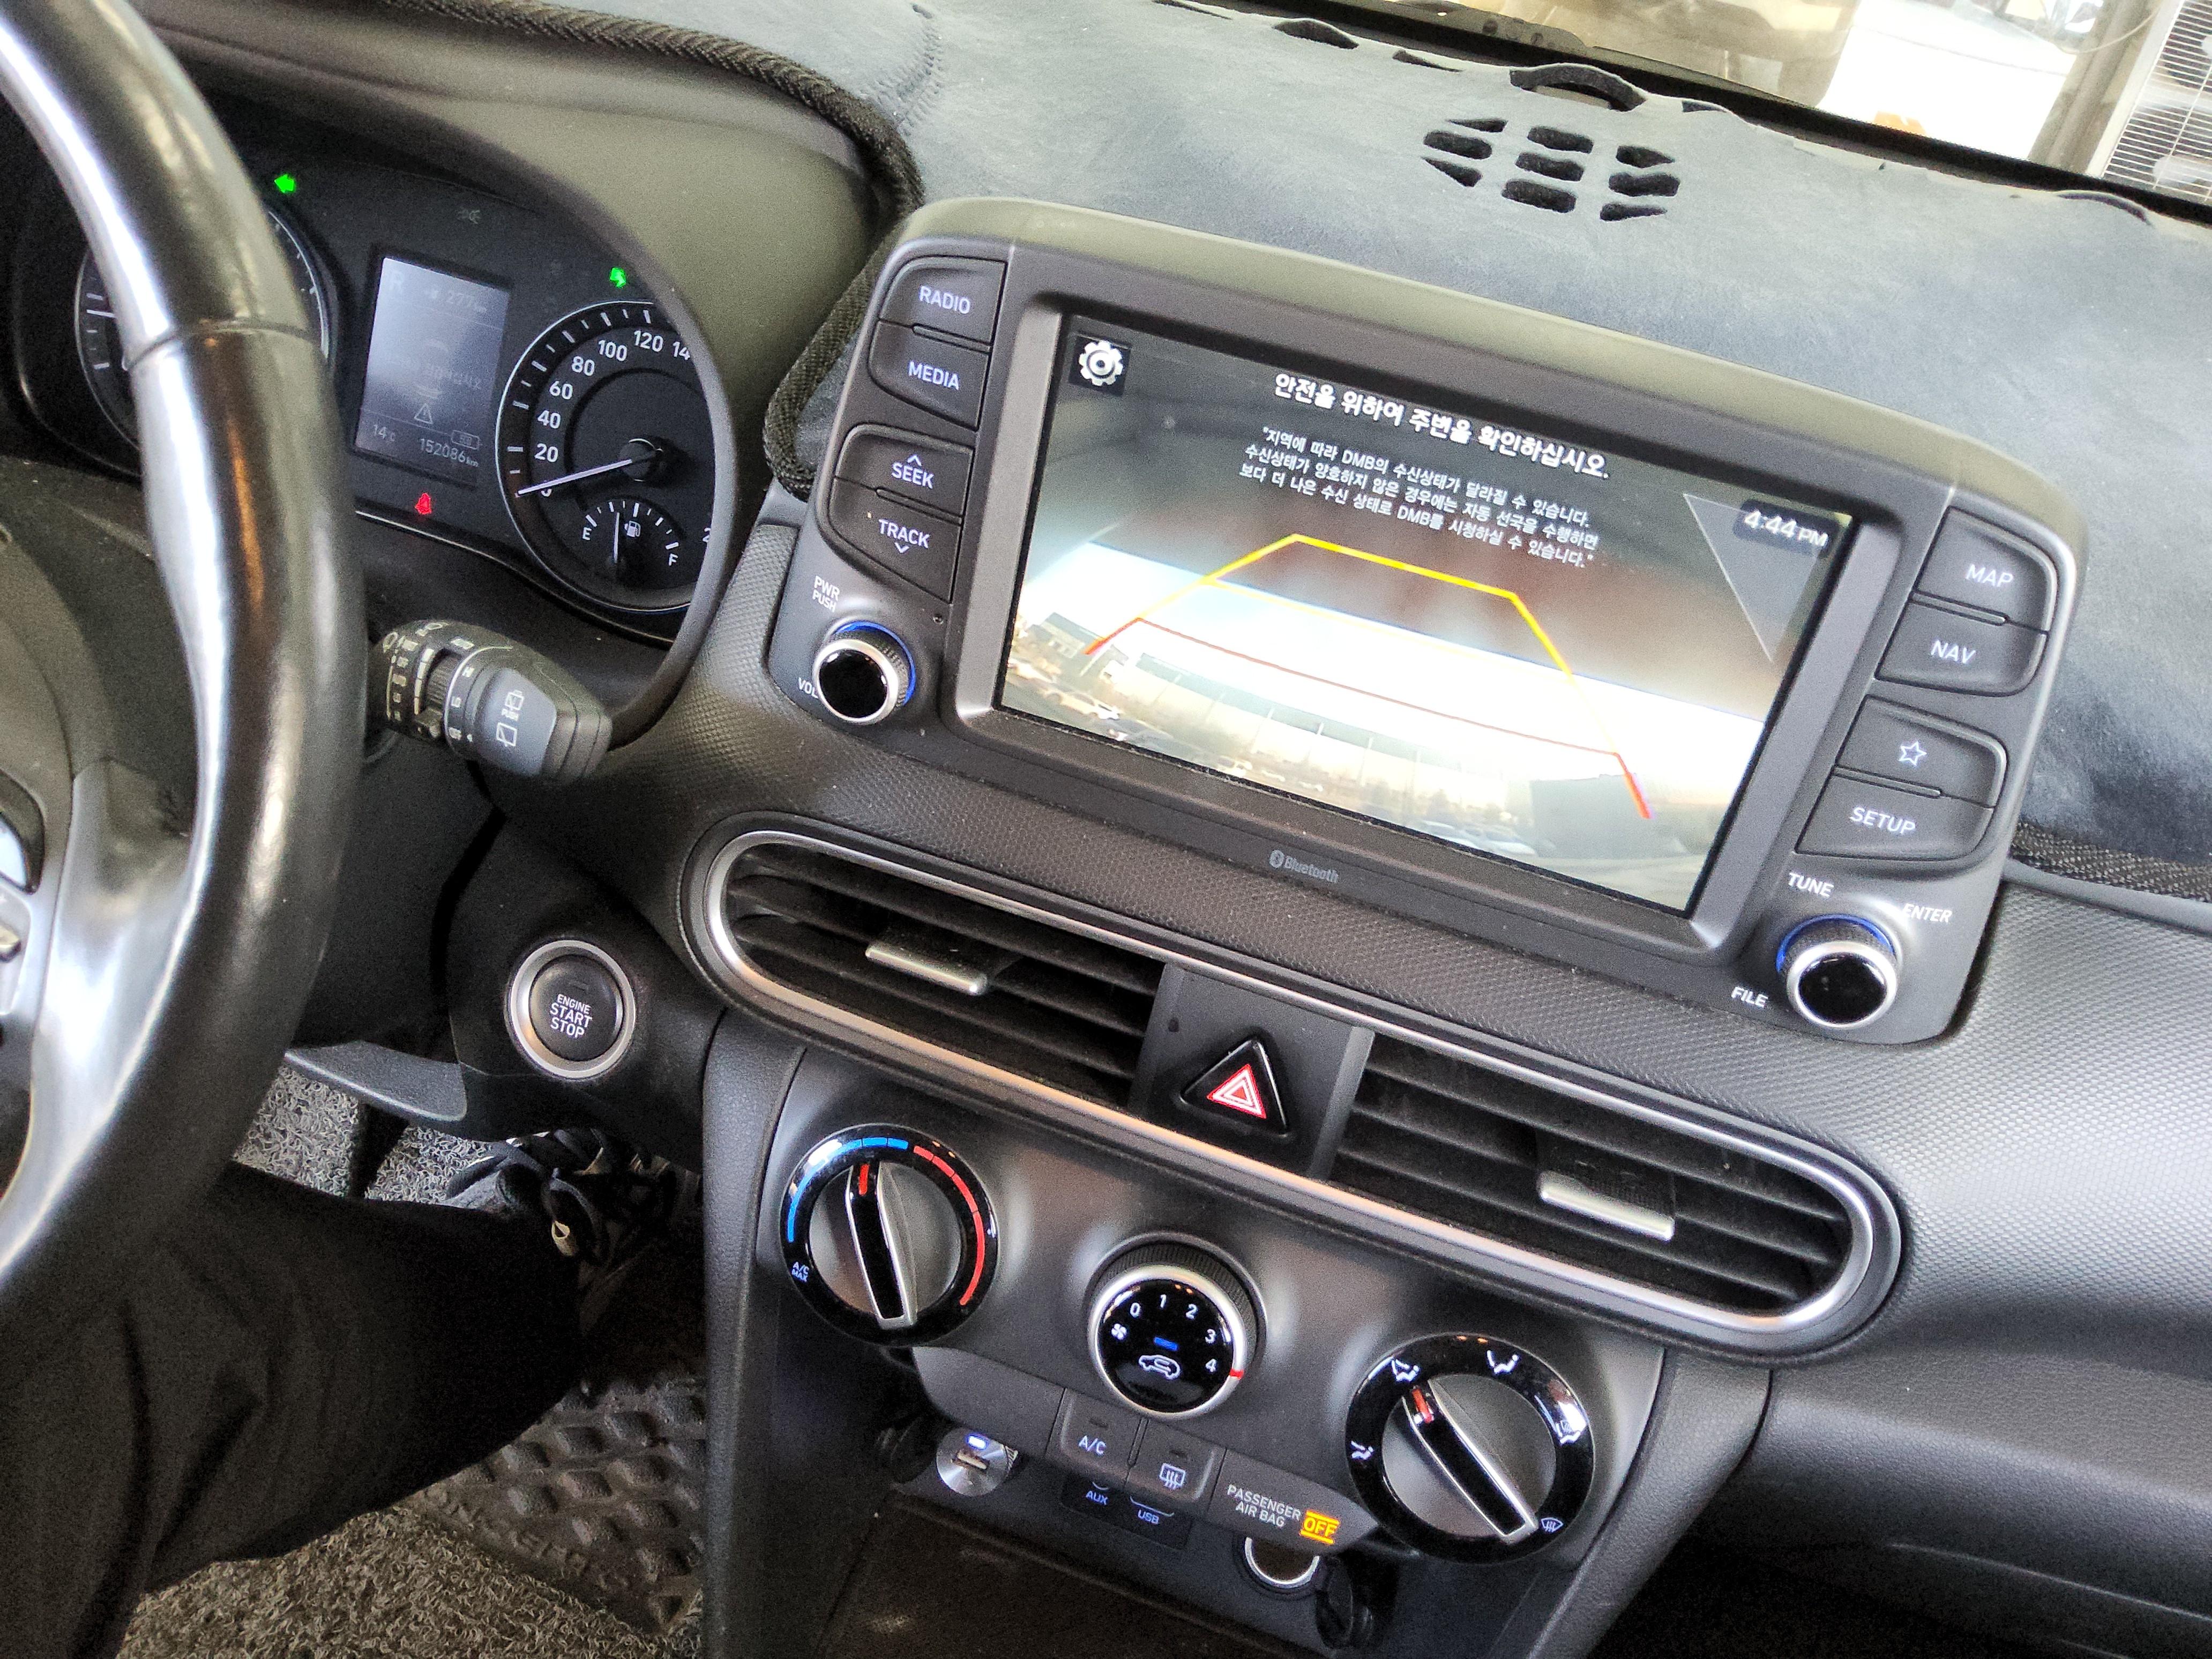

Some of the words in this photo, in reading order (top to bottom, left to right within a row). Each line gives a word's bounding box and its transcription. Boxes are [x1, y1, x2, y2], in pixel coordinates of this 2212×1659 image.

[919, 285, 971, 315] RADIO
[598, 340, 628, 362] 100
[633, 330, 663, 353] 120
[571, 356, 595, 376] 80
[908, 361, 961, 391] MEDIA
[549, 380, 573, 400] 60
[537, 410, 562, 429] 40
[1274, 373, 1336, 409] 안전을
[1341, 391, 1405, 427] 위하여
[1409, 408, 1473, 445] 주변을
[1478, 425, 1609, 479] 확인하십시오.
[534, 443, 558, 462] 20
[892, 461, 935, 489] SEEK
[1310, 441, 1339, 461] 따라
[1342, 450, 1389, 475] DMB의
[1393, 464, 1460, 493] 수신상태가
[1466, 482, 1508, 506] 달라질
[1512, 494, 1527, 510] 수
[1532, 499, 1589, 527] 있습니다.
[1239, 463, 1266, 482] 보다
[1272, 472, 1286, 488] 더
[1290, 476, 1317, 496] 나은
[1321, 484, 1349, 505] 수신
[1353, 493, 1393, 515] 상태로
[1397, 505, 1444, 530] DMB를
[1448, 518, 1503, 546] 시청하실
[1507, 535, 1522, 550] 수
[1245, 444, 1310, 474] 수신상태가
[1315, 462, 1367, 489] 양호하지
[1372, 477, 1400, 498] 않은
[1405, 485, 1458, 513] 경우에는
[1462, 502, 1490, 521] 자동
[1496, 511, 1538, 534] 선국을
[1542, 523, 1598, 551] 수행하면
[582, 527, 593, 541] E
[878, 519, 930, 550] TRACK
[1744, 510, 1797, 538] 4:44
[1798, 527, 1828, 547] PM
[669, 553, 678, 566] F
[1965, 563, 2013, 588] MAP
[814, 576, 840, 601] PWR
[812, 589, 836, 612] PUSH
[1930, 640, 1976, 665] NAV
[798, 677, 819, 699] VOL
[1849, 805, 1916, 838] SETUP
[1284, 855, 1339, 883] Bluetooth
[1788, 871, 1835, 898] TUNE
[1902, 903, 1953, 924] ENTER
[557, 993, 591, 1014] ENGINE
[1731, 987, 1768, 1008] FILE
[550, 1003, 593, 1028] START
[550, 1017, 585, 1038] STOP
[1130, 1302, 1141, 1318] 0
[1160, 1294, 1167, 1308] 1
[1186, 1304, 1198, 1320] 2
[1205, 1328, 1216, 1344] 3
[1206, 1358, 1217, 1372] 4
[1079, 1436, 1107, 1455] A/C
[1086, 1490, 1108, 1505] AUX
[1227, 1484, 1301, 1521] PASSENGER
[1138, 1509, 1160, 1525] USB
[1236, 1501, 1257, 1518] AIR
[1259, 1509, 1286, 1528] BAG
[1304, 1516, 1337, 1537] OFF
